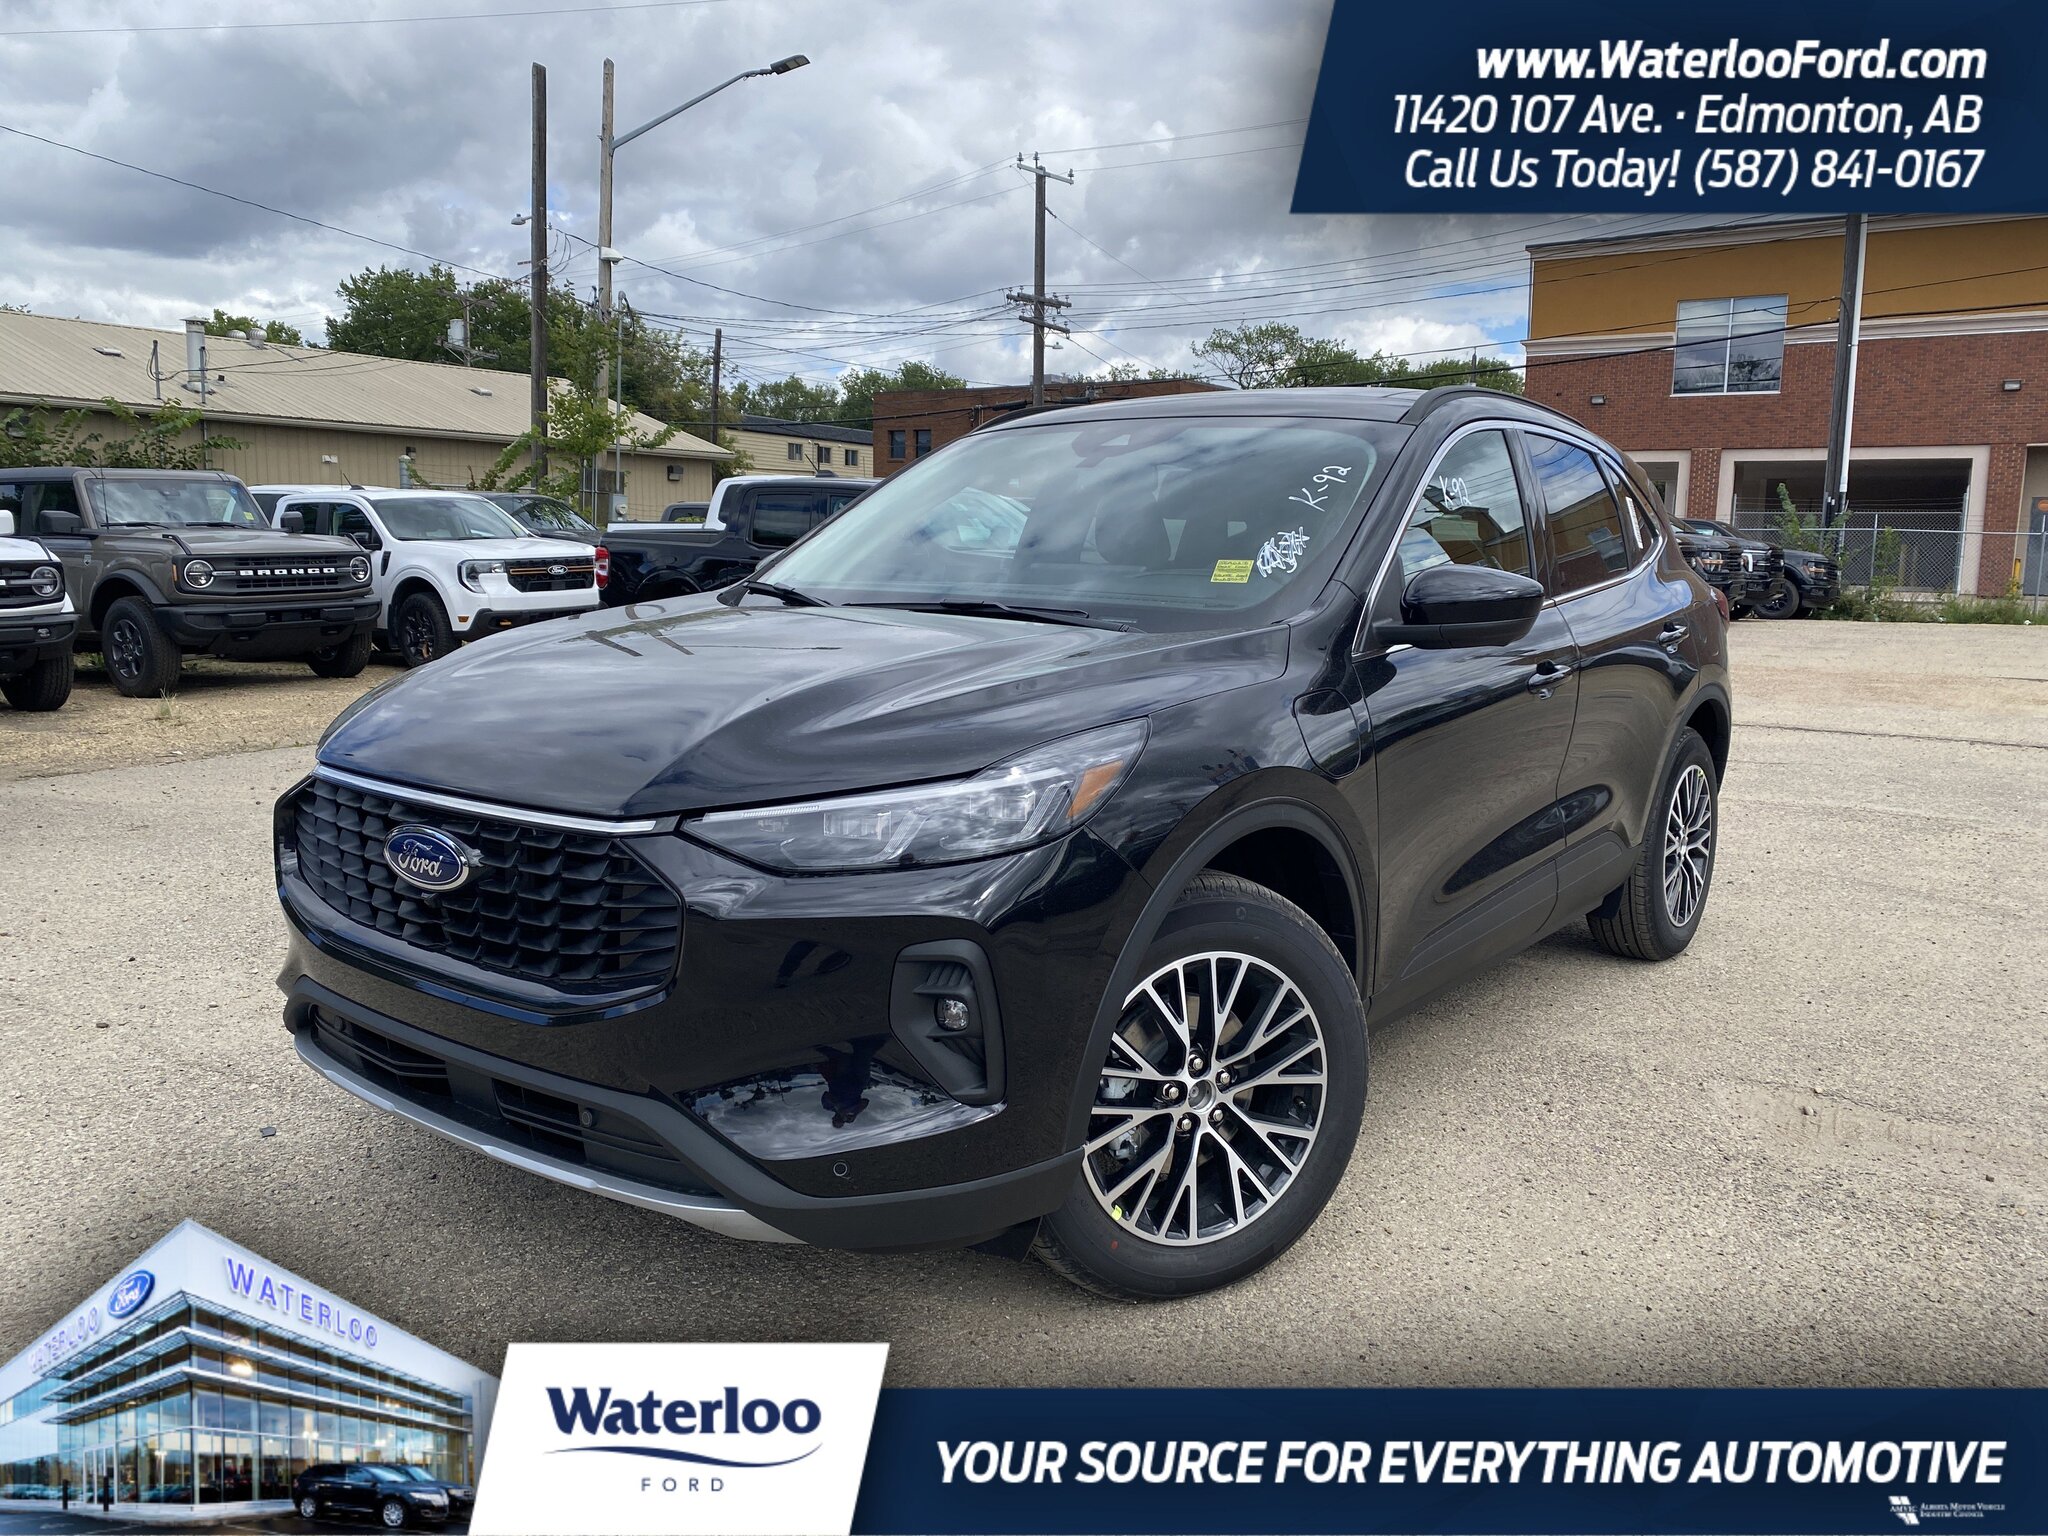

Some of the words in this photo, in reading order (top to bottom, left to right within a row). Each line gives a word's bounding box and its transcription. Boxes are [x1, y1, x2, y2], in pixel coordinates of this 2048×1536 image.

[1288, 465, 1352, 512] K-92
[239, 567, 336, 576] BRONCO
[398, 838, 443, 877] Ford
